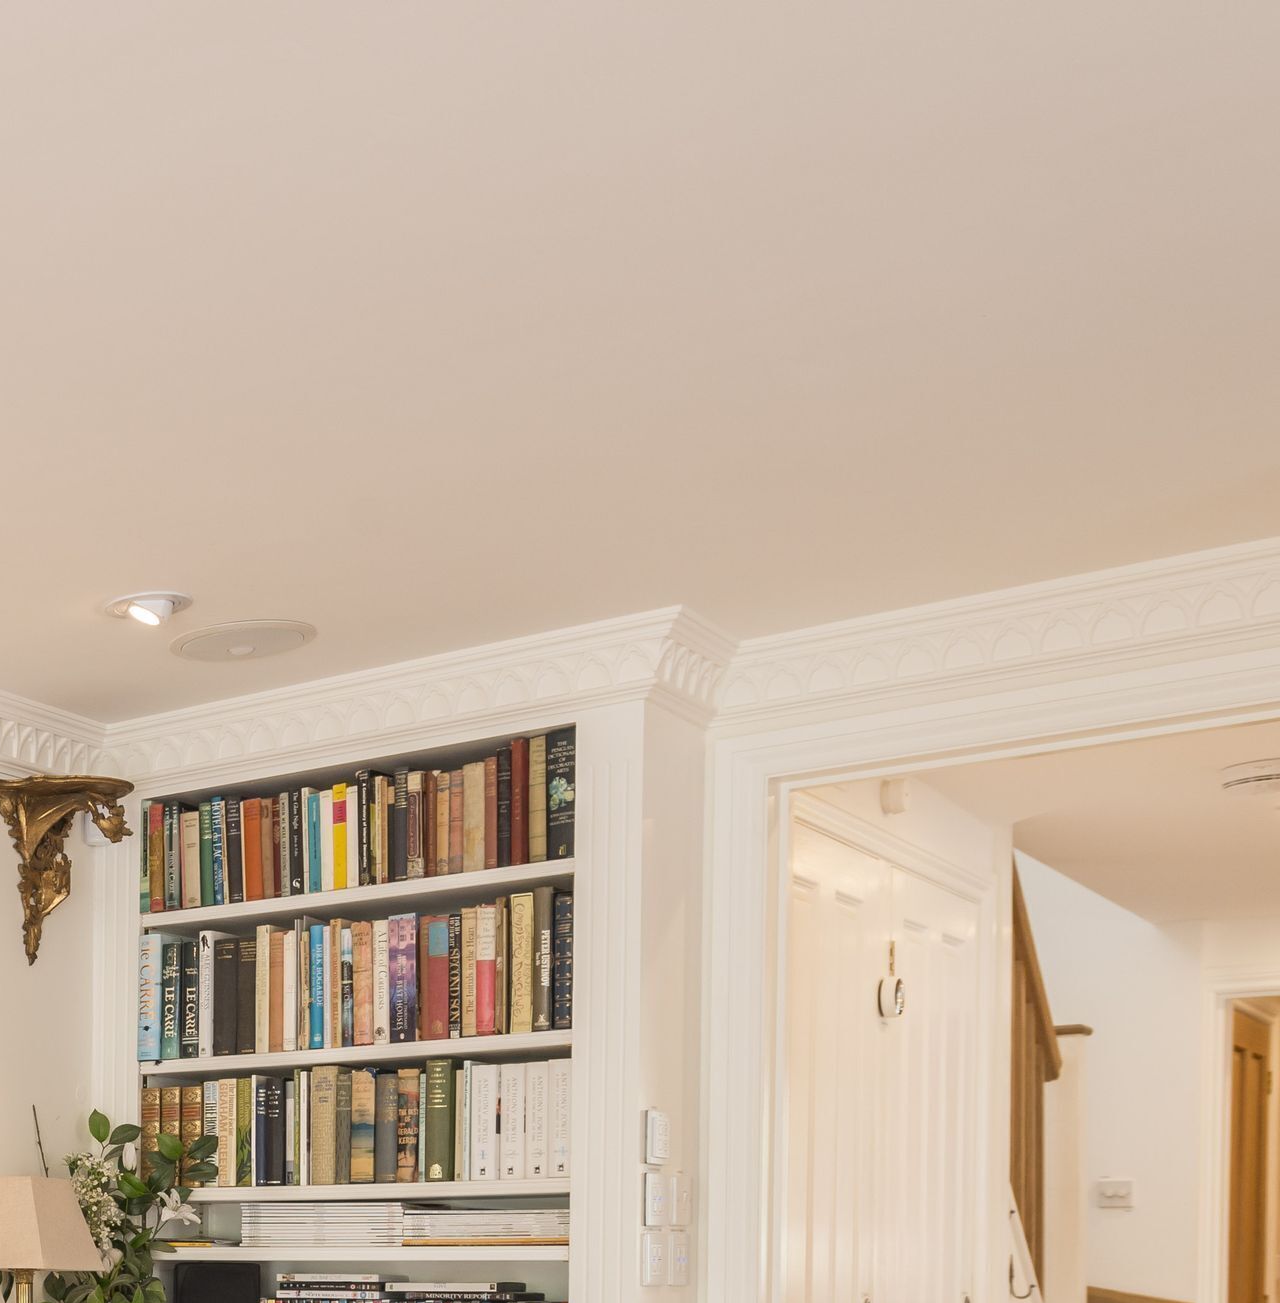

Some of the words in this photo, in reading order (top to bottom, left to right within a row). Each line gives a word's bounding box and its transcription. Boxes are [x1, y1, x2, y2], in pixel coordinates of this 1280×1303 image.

[212, 801, 222, 828] HOTEL
[213, 843, 222, 860] LAC
[541, 929, 550, 954] PETER
[450, 948, 460, 996] SECOND
[541, 954, 550, 986] USTINOV
[165, 987, 174, 1002] LE
[186, 987, 196, 1002] LE
[164, 1003, 176, 1038] CARRÉ
[185, 1002, 197, 1036] CARRÉ
[450, 999, 460, 1021] SON
[219, 1082, 228, 1131] GRAHAM
[219, 1135, 228, 1185] GREENE
